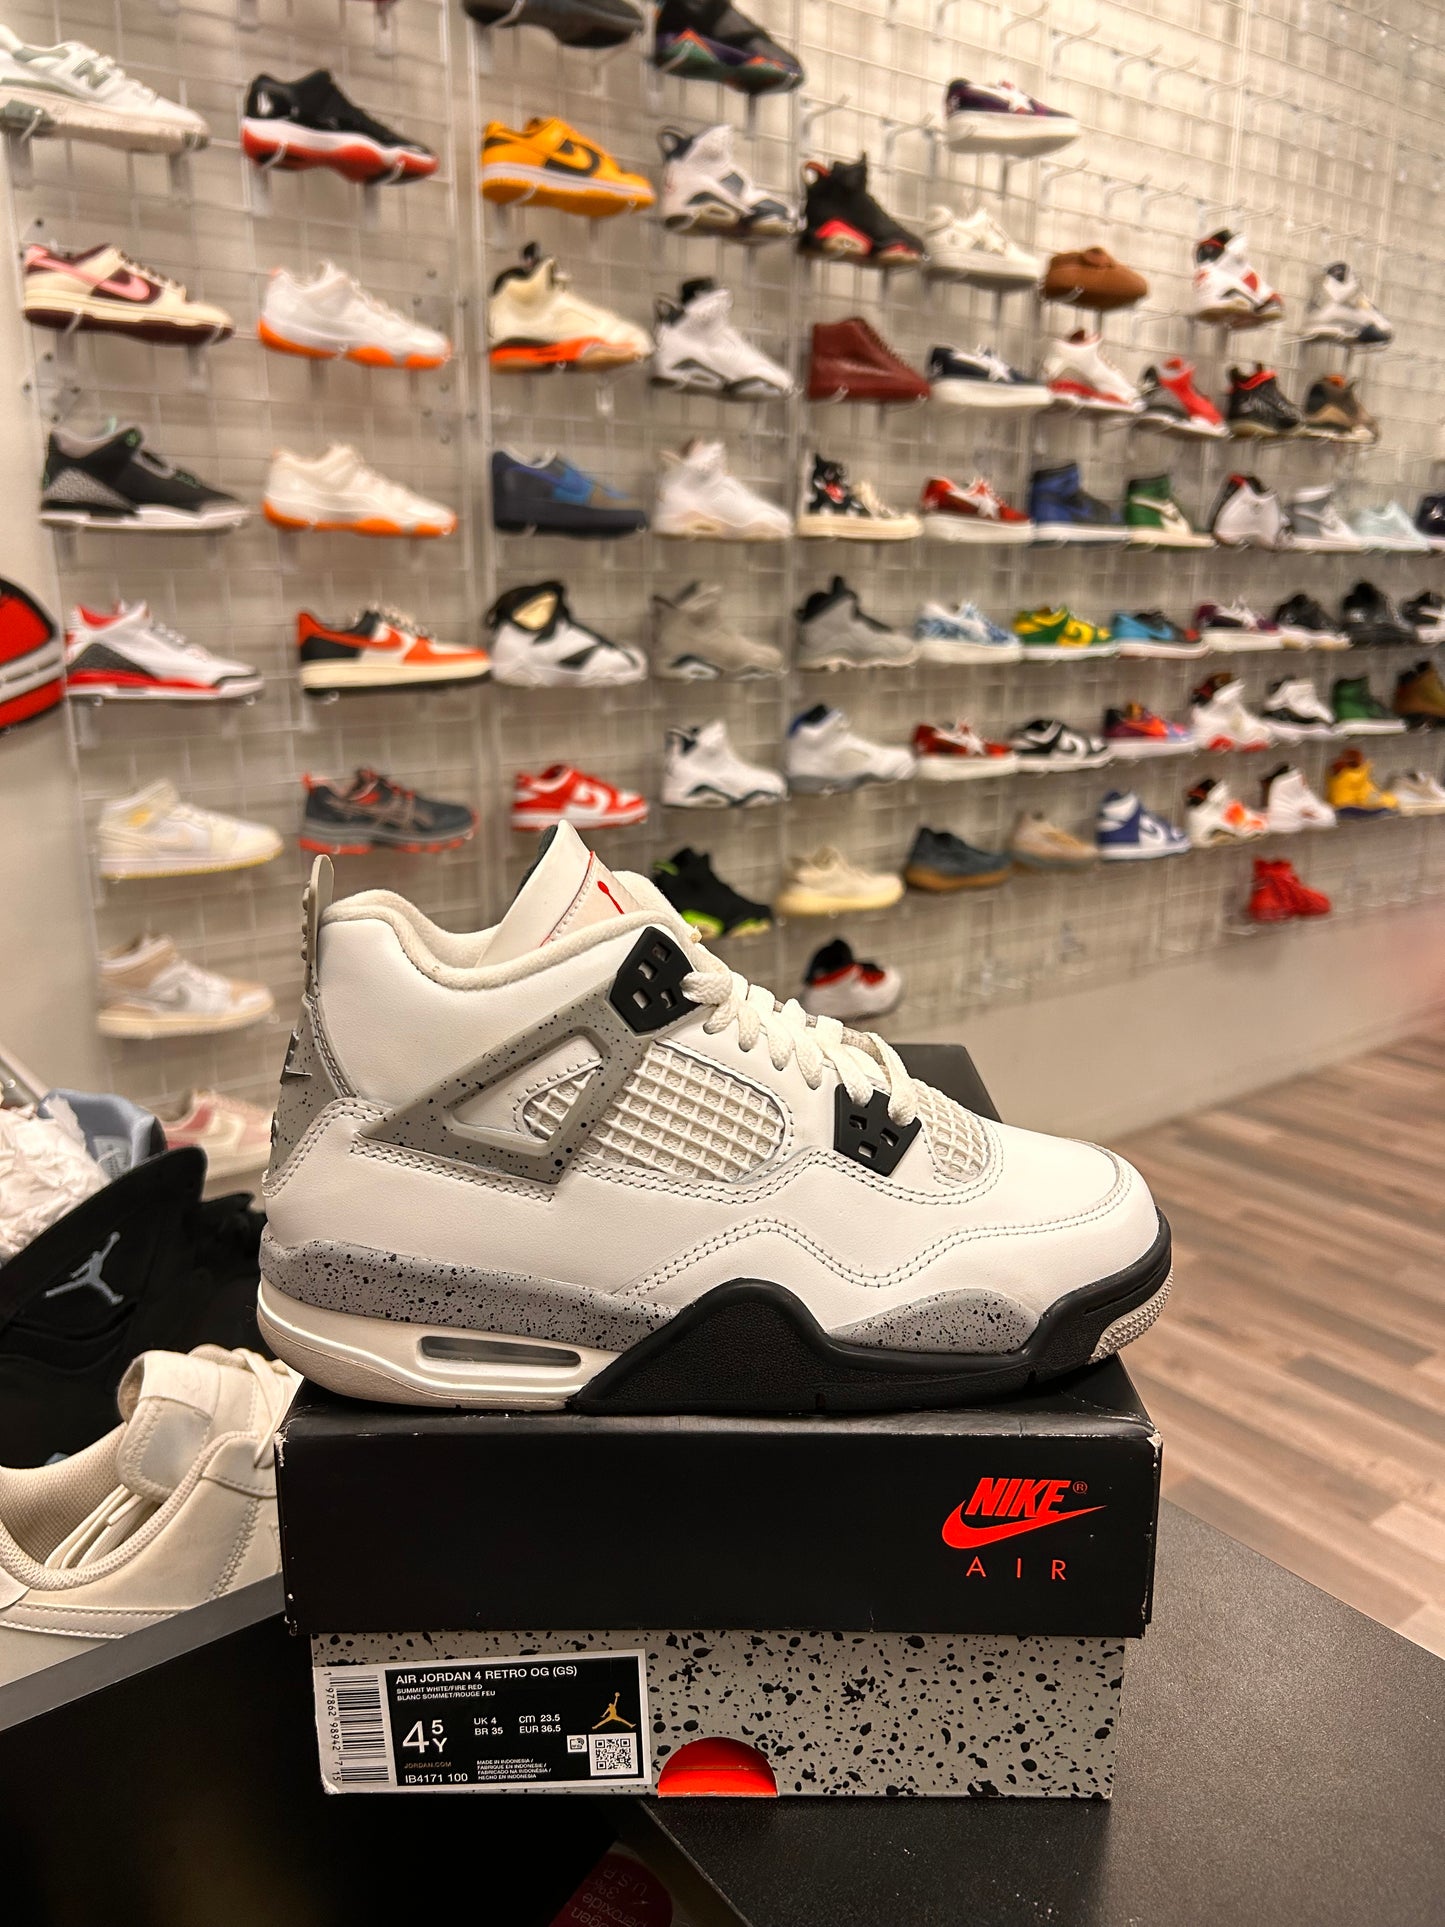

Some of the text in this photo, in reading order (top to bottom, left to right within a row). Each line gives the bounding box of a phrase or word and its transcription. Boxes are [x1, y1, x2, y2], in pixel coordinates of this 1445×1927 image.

[396, 1666, 578, 1685] AIR JORDAN 4 RETRO OG (GS)
[422, 1692, 480, 1700] SOMMET/ROUGE
[325, 1688, 336, 1716] 97862
[474, 1717, 497, 1725] UK 4
[518, 1714, 560, 1724] cm 23.5
[474, 1727, 504, 1736] BR 35
[519, 1724, 562, 1734] EUR 36.5
[330, 1722, 340, 1751] 98942
[402, 1719, 444, 1754] 4 5
[432, 1737, 448, 1753] Y
[404, 1761, 452, 1770] JORDAN.COM
[332, 1772, 341, 1782] 15
[405, 1773, 468, 1784] IB4171 100
